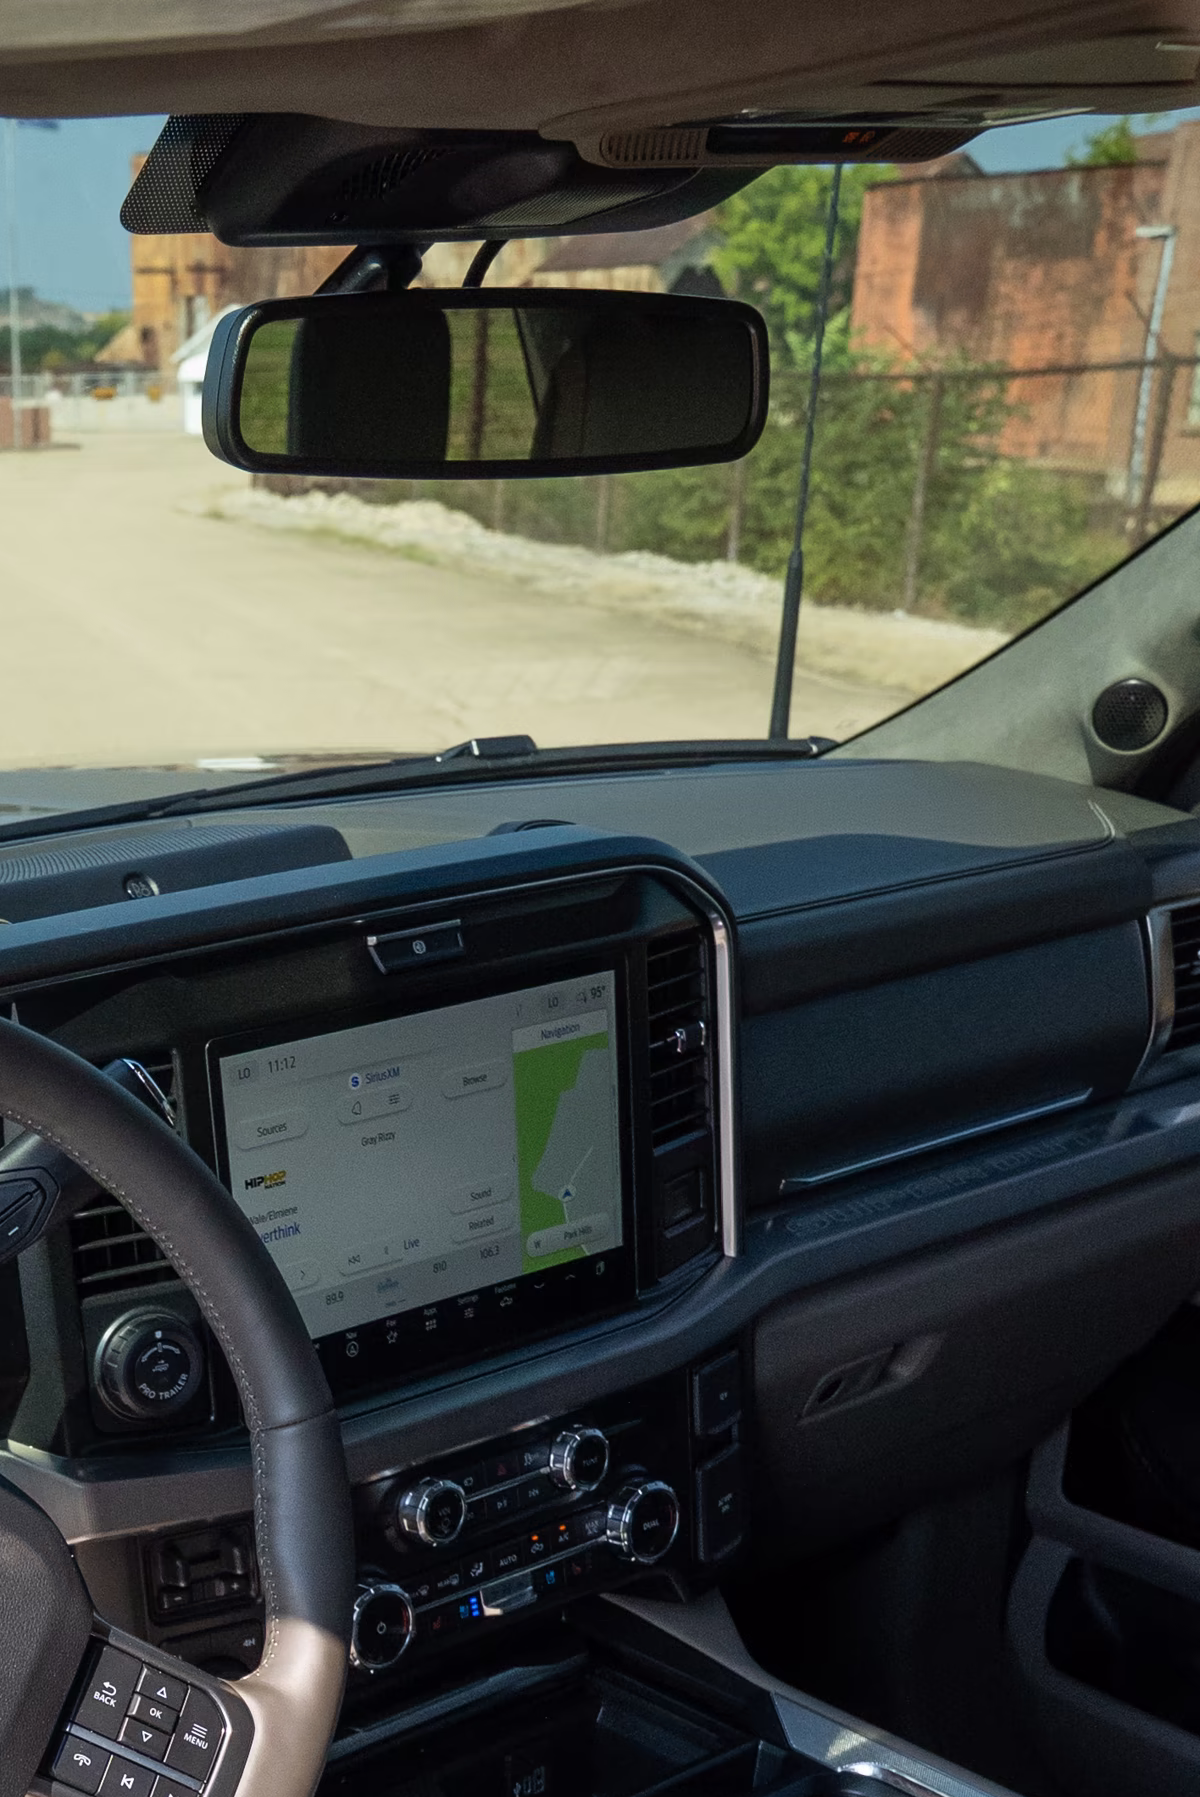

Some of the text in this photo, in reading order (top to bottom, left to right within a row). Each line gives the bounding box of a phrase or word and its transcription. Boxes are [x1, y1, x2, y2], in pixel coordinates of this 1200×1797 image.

[541, 1023, 580, 1040] Navigation
[268, 1056, 296, 1073] 11:12
[238, 1067, 250, 1080] LO
[365, 1066, 400, 1085] SiriusXM
[463, 1074, 487, 1087] Browse
[257, 1123, 287, 1137] Sources
[403, 1238, 420, 1250] Live
[433, 1260, 447, 1274] 810
[139, 1373, 188, 1400] PRO TRAILER
[500, 1554, 517, 1567] AUTO
[93, 1691, 117, 1708] BACK
[149, 1707, 163, 1719] OK
[183, 1732, 209, 1750] MENU
